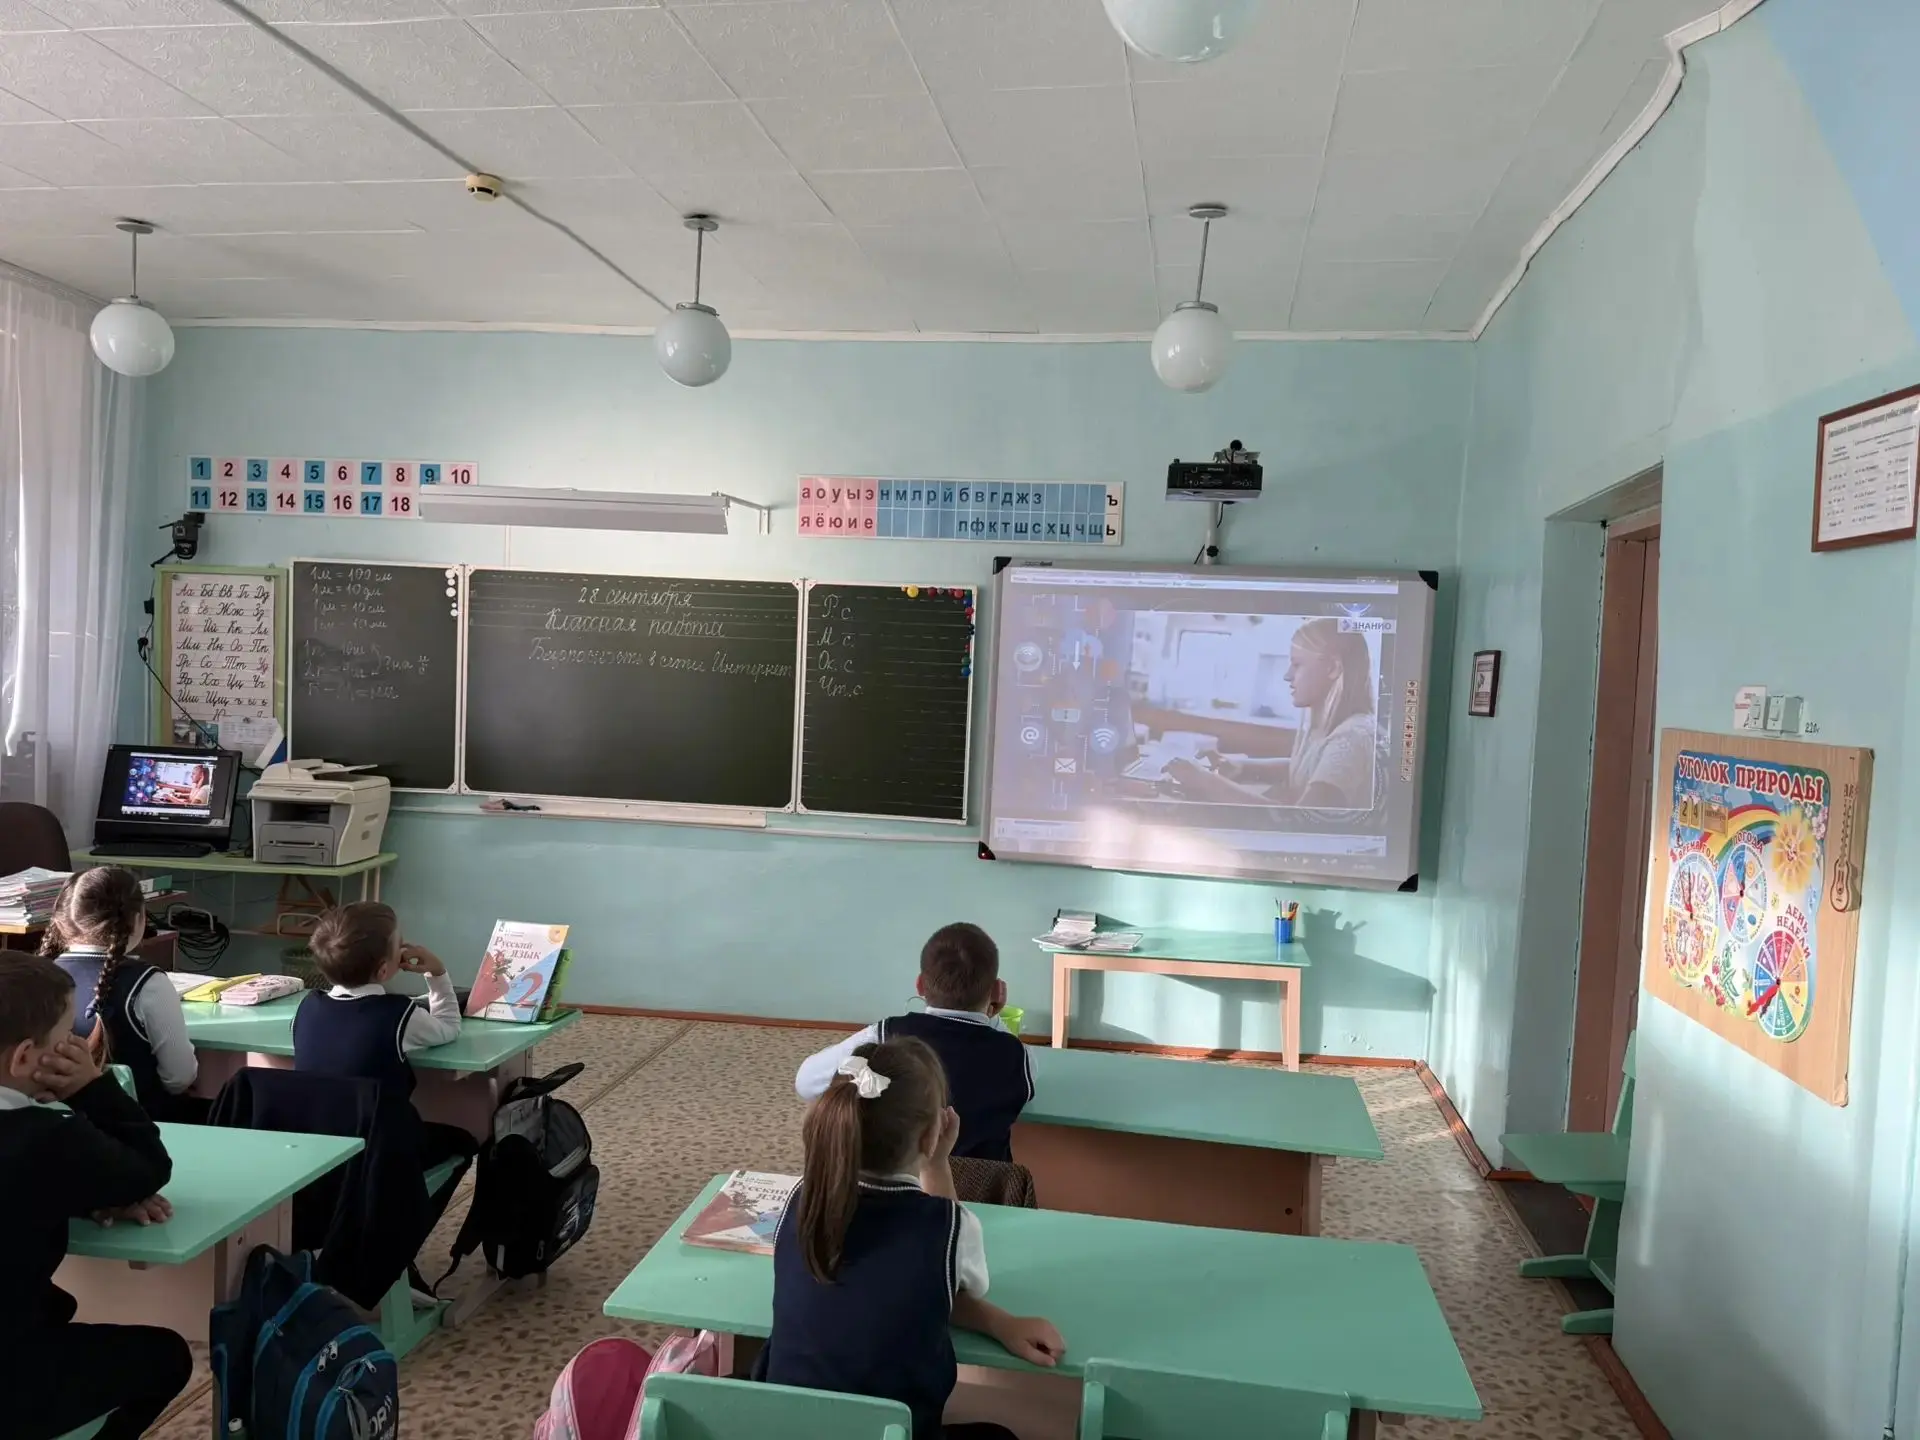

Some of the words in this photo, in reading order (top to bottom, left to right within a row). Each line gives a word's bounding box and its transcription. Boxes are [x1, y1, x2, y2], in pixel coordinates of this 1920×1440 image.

[197, 463, 204, 476] 1
[224, 462, 233, 477] 2
[252, 463, 262, 478] 3
[281, 464, 291, 478] 4
[310, 465, 319, 480] 5
[338, 466, 347, 480] 6
[367, 467, 376, 481] 7
[396, 467, 405, 482] 8
[425, 468, 434, 483] 9
[451, 469, 470, 484] 10
[192, 491, 208, 505] 11
[219, 492, 237, 506] 12
[248, 492, 266, 507] 13
[277, 493, 295, 509] 14
[306, 494, 324, 509] 15
[334, 495, 352, 510] 16
[363, 496, 381, 511] 17
[392, 497, 410, 512] 18
[578, 587, 600, 605] 28
[605, 583, 693, 614] сентября
[544, 608, 637, 632] Классная
[648, 612, 726, 637] работа
[1352, 621, 1392, 631] ЗНАНИО
[1679, 755, 1729, 785] УГОЛОК
[1735, 766, 1824, 802] ПРИРОДЫ
[1732, 831, 1763, 855] ПОГОДА
[1786, 903, 1808, 934] ДЕНЬ
[493, 936, 534, 949] Русский
[1776, 916, 1811, 959] НЕДЕЛИ
